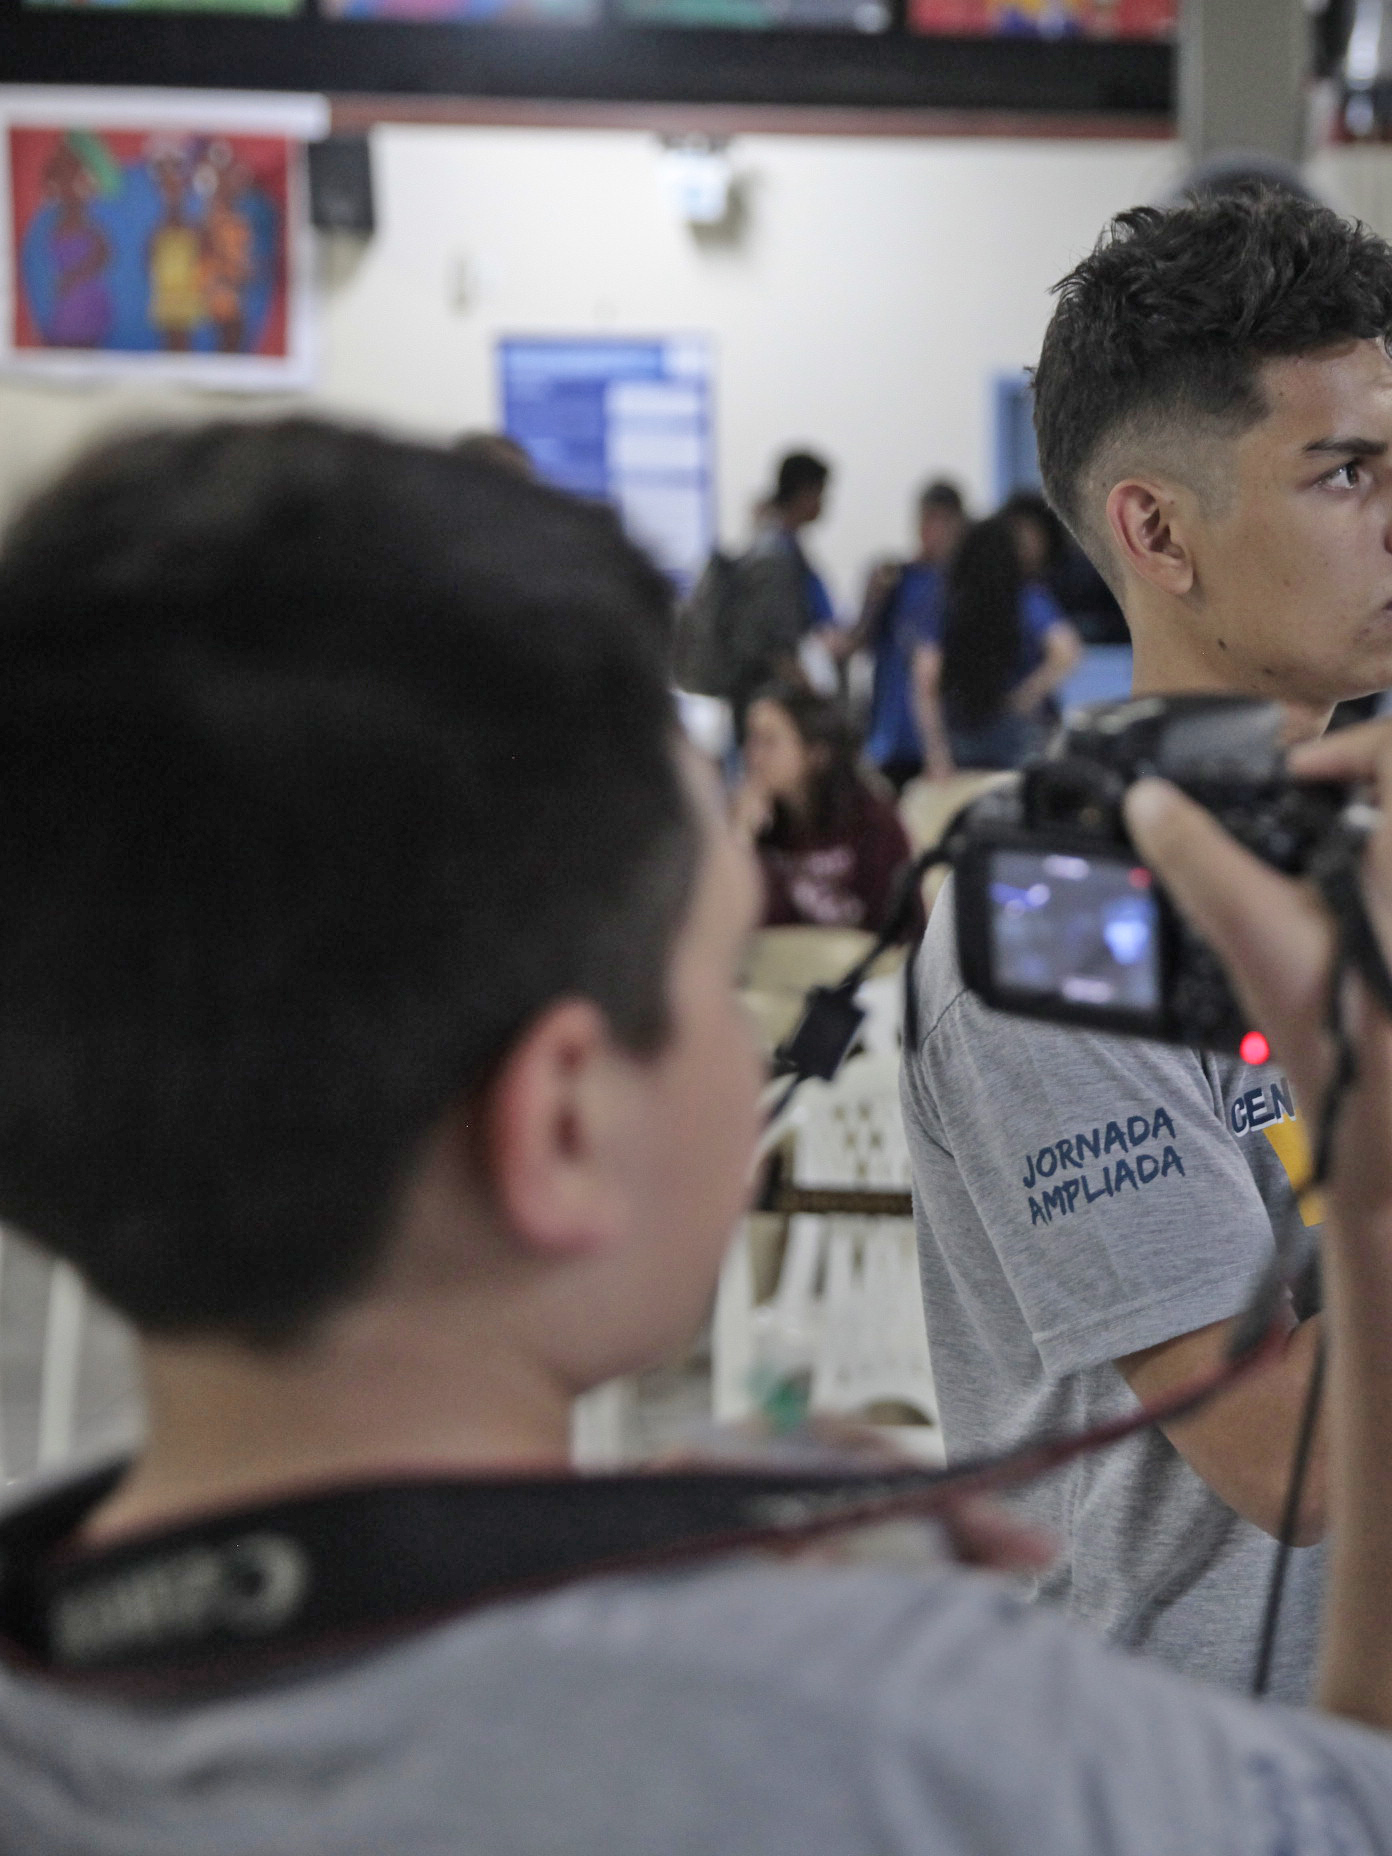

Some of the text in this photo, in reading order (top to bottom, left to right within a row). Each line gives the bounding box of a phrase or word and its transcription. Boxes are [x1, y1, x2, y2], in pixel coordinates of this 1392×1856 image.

[1023, 1107, 1177, 1189] JORNADA
[1231, 1080, 1296, 1138] CEN
[1028, 1146, 1186, 1226] AMPLIADA
